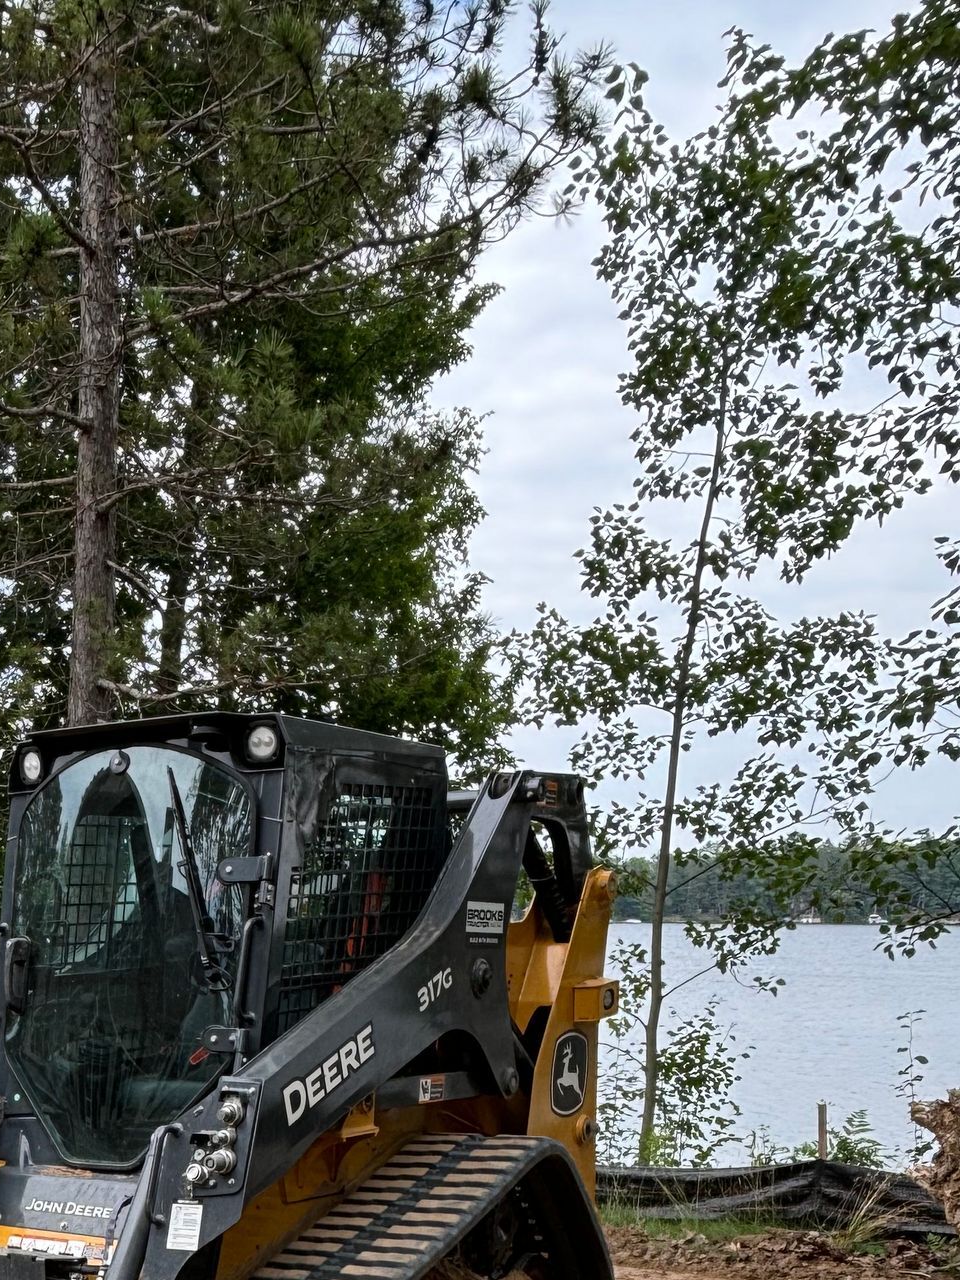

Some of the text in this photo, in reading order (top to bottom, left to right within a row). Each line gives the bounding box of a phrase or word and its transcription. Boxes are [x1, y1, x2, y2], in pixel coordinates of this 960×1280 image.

[467, 909, 504, 921] BROOKS
[417, 967, 453, 1012] 317G
[283, 1024, 375, 1127] DEERE
[25, 1199, 114, 1218] JOHN DEERE
